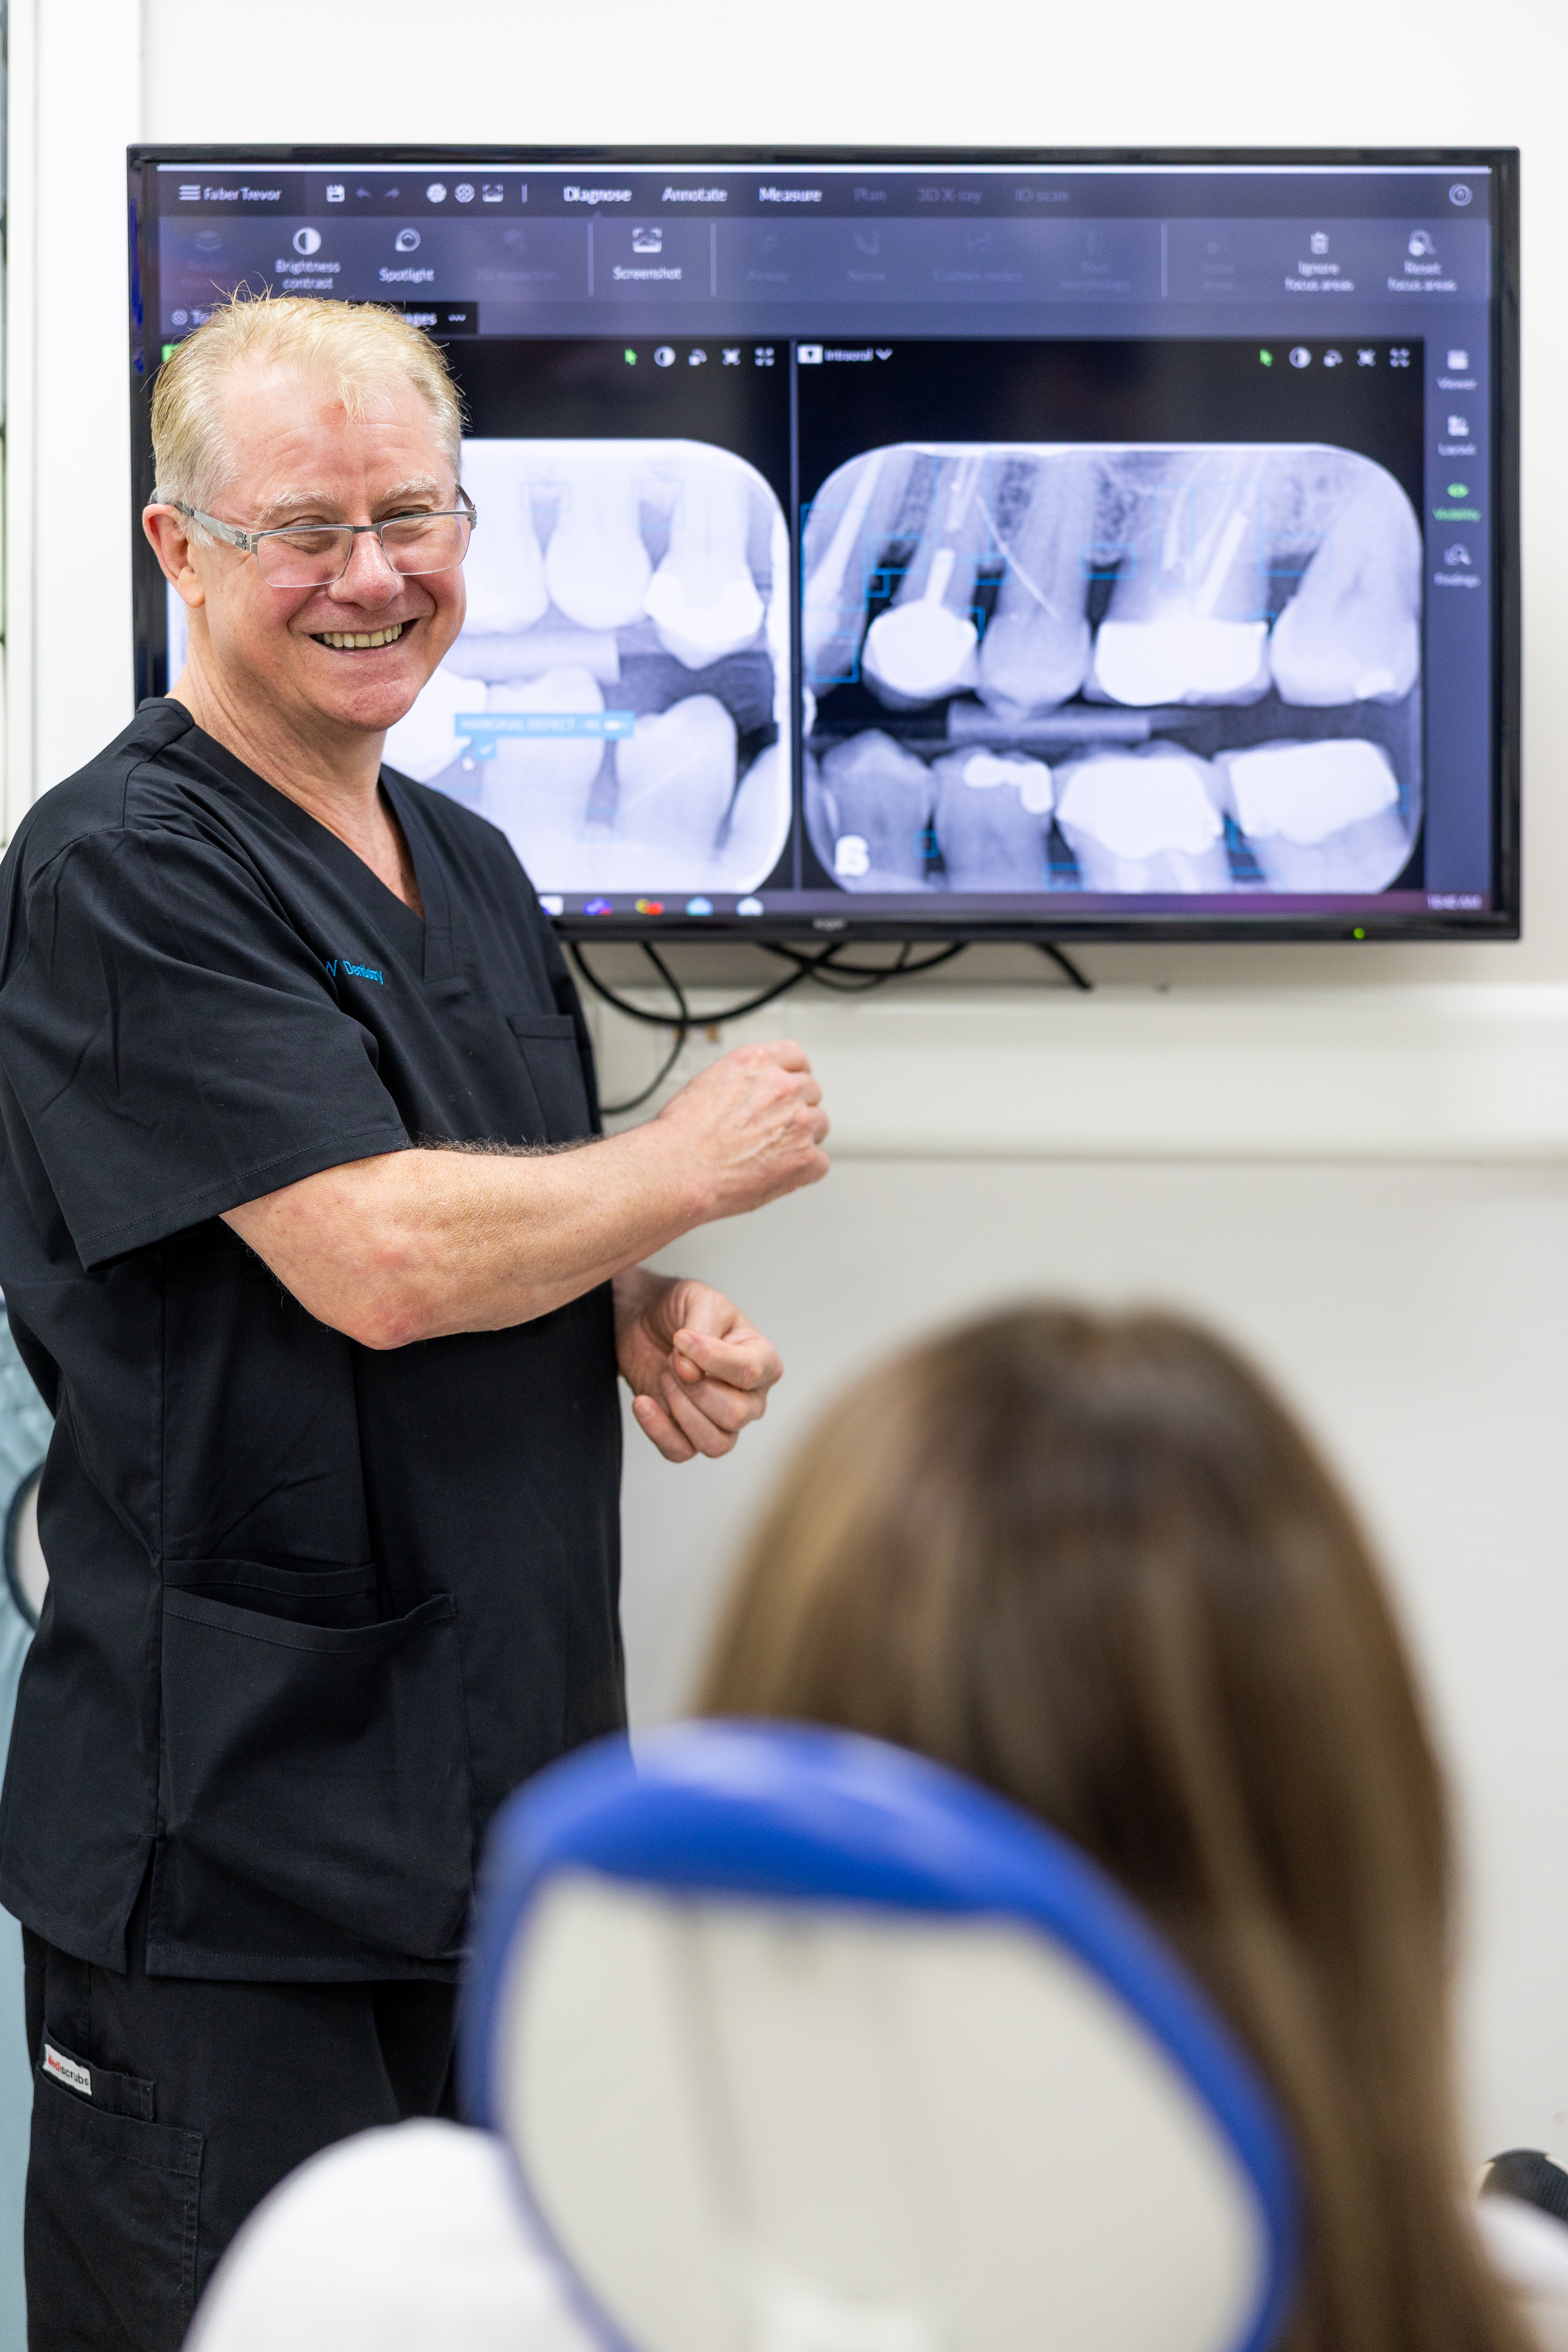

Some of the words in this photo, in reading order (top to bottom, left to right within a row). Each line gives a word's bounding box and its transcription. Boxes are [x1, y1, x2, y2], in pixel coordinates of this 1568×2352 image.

[203, 187, 240, 201] Faber
[240, 187, 282, 201] Trevor
[563, 186, 632, 205] Diagnose
[661, 187, 728, 202] Annotate
[759, 187, 822, 202] Measure
[853, 188, 887, 202] Plan
[275, 259, 340, 275] Brightness
[613, 265, 682, 280] Screenshot
[1298, 260, 1340, 277] Ignore
[282, 276, 333, 290] contrast
[379, 267, 434, 284] Spotlight
[343, 960, 383, 985] Dentistry
